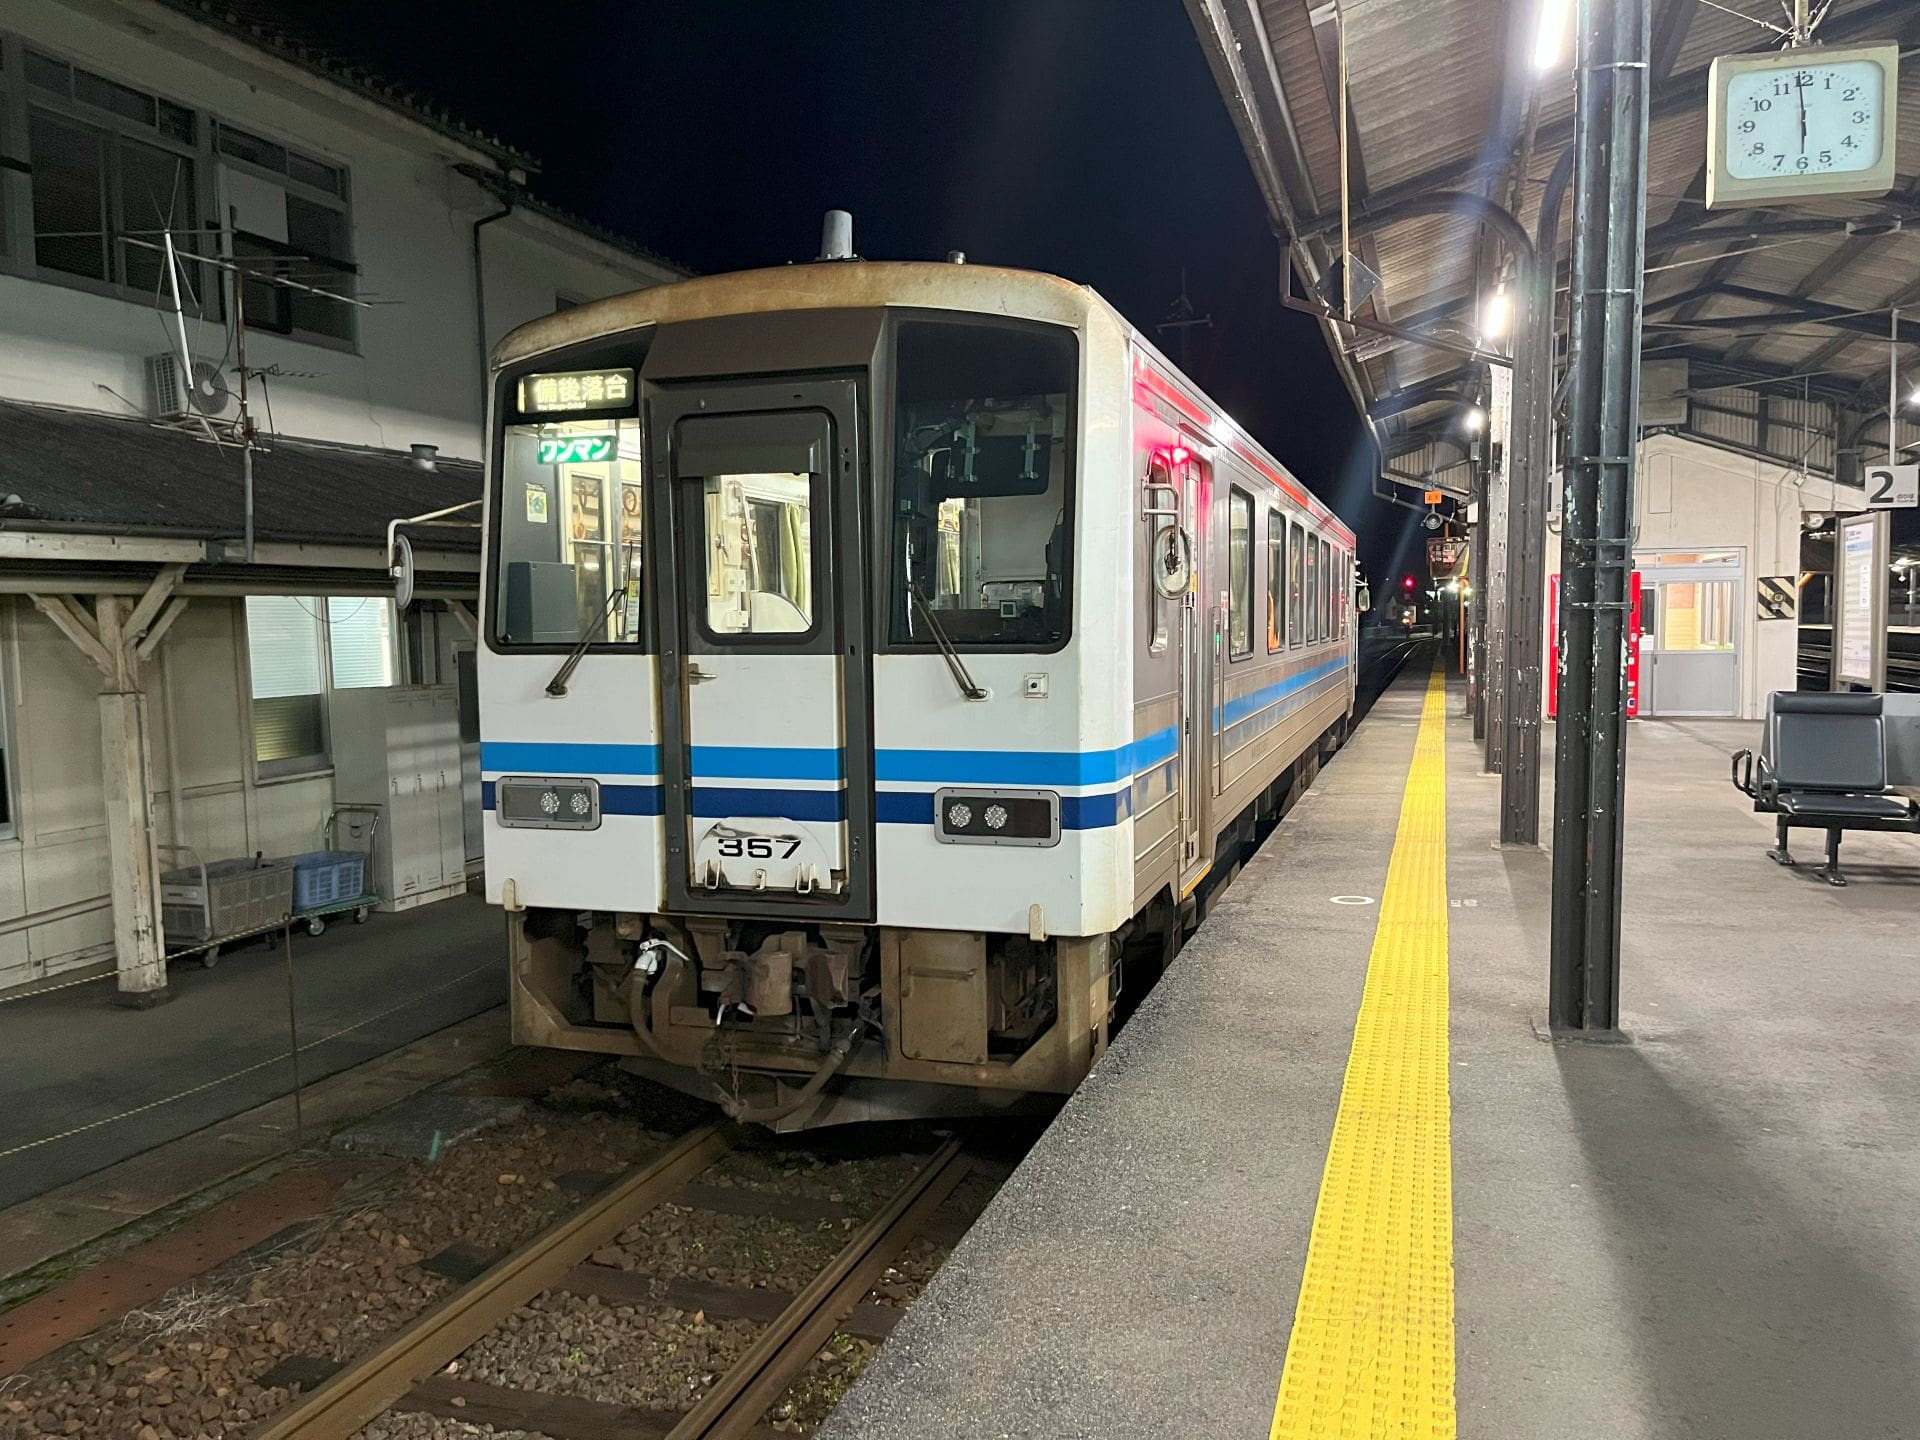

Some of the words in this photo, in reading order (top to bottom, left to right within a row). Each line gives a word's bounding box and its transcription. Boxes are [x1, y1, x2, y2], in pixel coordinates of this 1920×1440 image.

[1794, 74, 1814, 87] 12
[1824, 78, 1832, 89] 1
[1774, 83, 1790, 95] 11
[1842, 89, 1855, 101] 2
[1753, 99, 1772, 112] 10
[1852, 111, 1864, 124] 3
[1743, 120, 1755, 133] 9
[1841, 135, 1854, 148] 4
[1752, 142, 1764, 155] 8
[1773, 154, 1785, 167] 7
[1796, 156, 1808, 169] 6
[1819, 150, 1832, 163] 5
[534, 374, 628, 403] 備後落合
[540, 438, 611, 463] ワンマン
[1870, 471, 1894, 503] 2
[718, 838, 801, 860] 357
